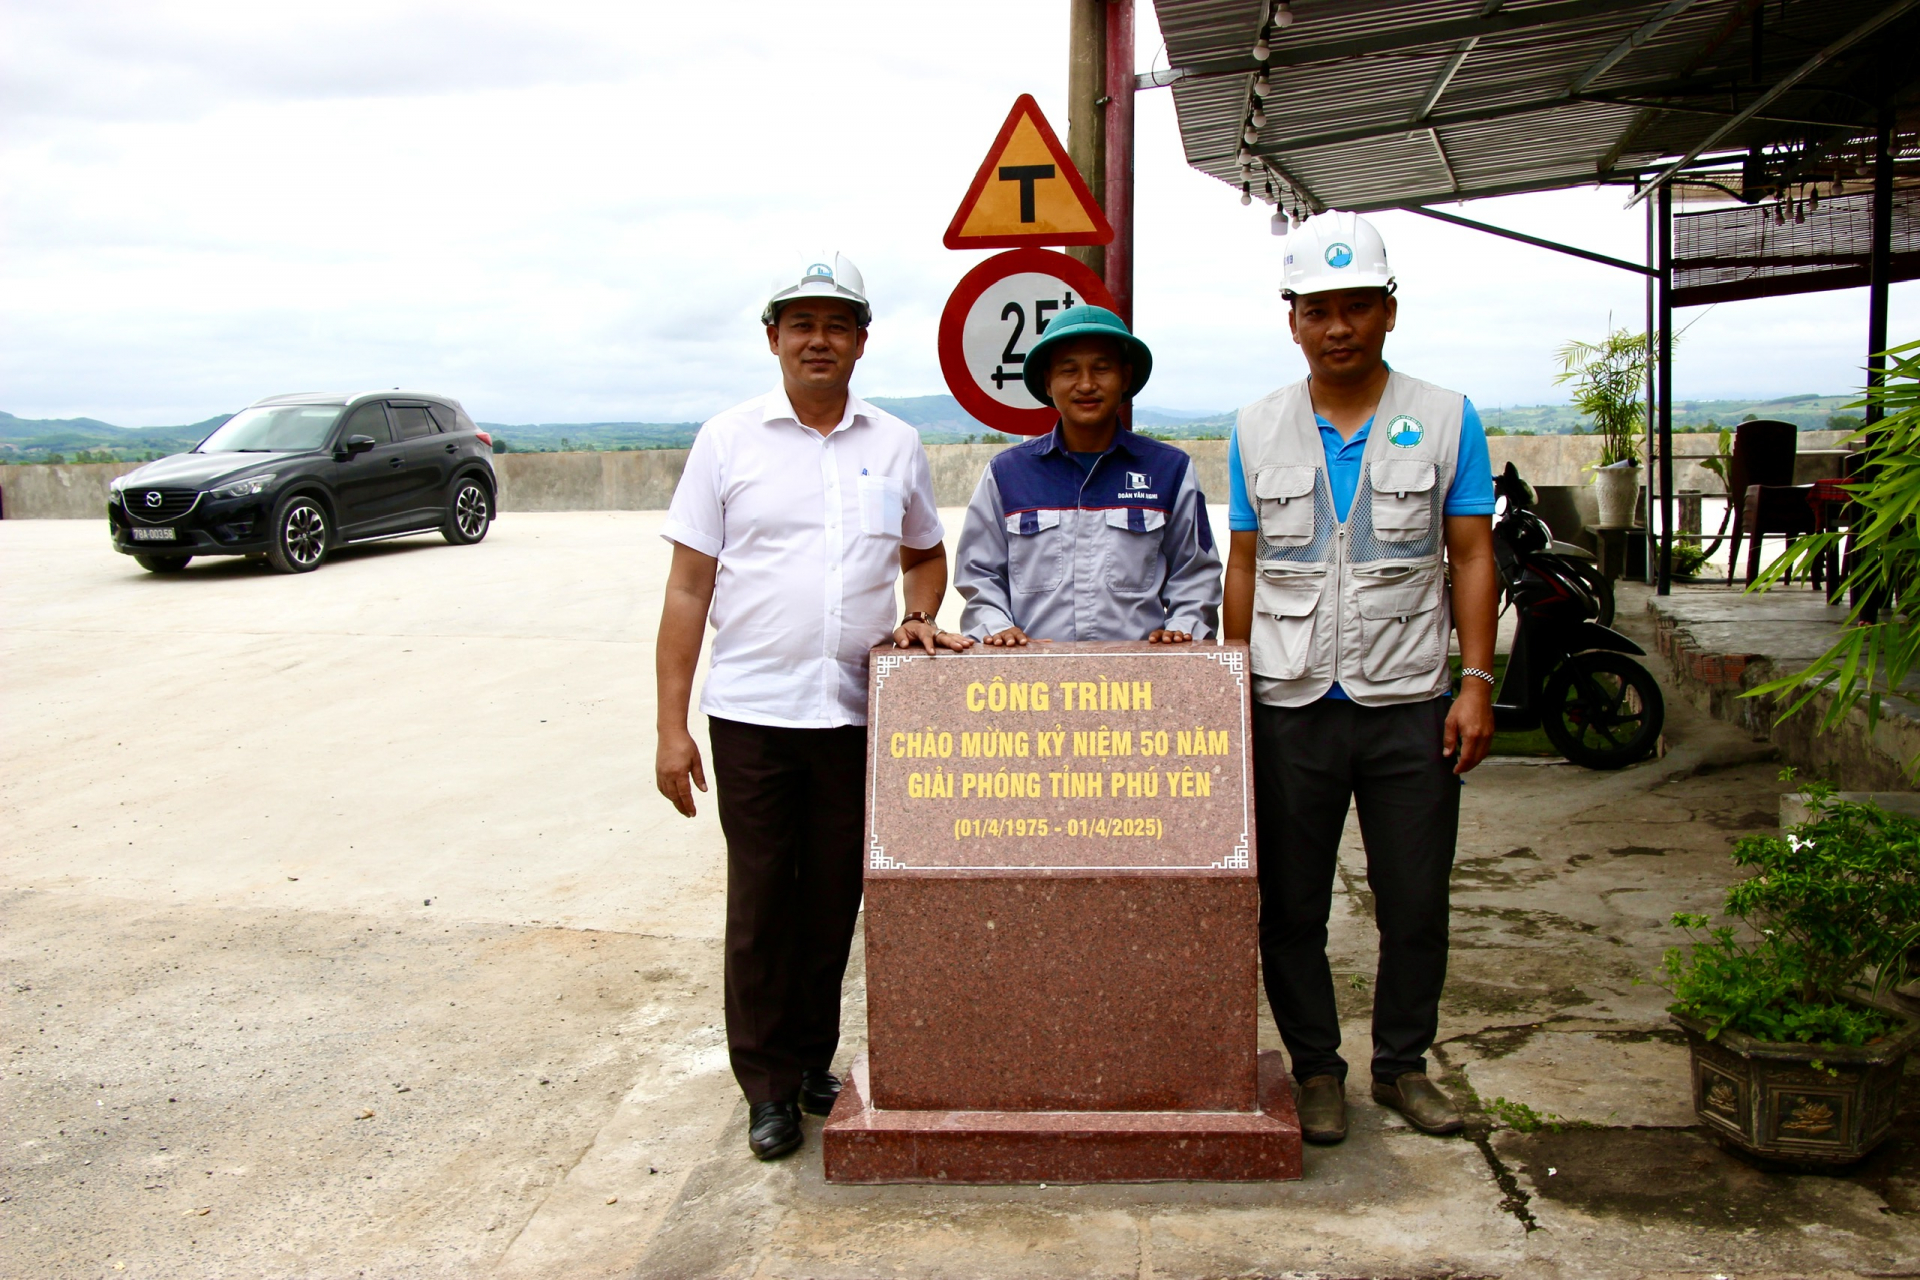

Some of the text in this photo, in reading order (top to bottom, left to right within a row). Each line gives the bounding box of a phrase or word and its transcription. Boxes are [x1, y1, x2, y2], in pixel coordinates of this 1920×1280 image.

[966, 675, 1153, 712] CÔNG TRÌNH
[891, 724, 1230, 763] CHÀO MỪNG KỶ NIỆM 50 NĂM
[909, 765, 1212, 799] GIẢI PHÓNG TỈNH PHÚ YÊN
[954, 819, 1049, 841] (01/4/1975
[1068, 818, 1164, 840] 01/4/2025)
